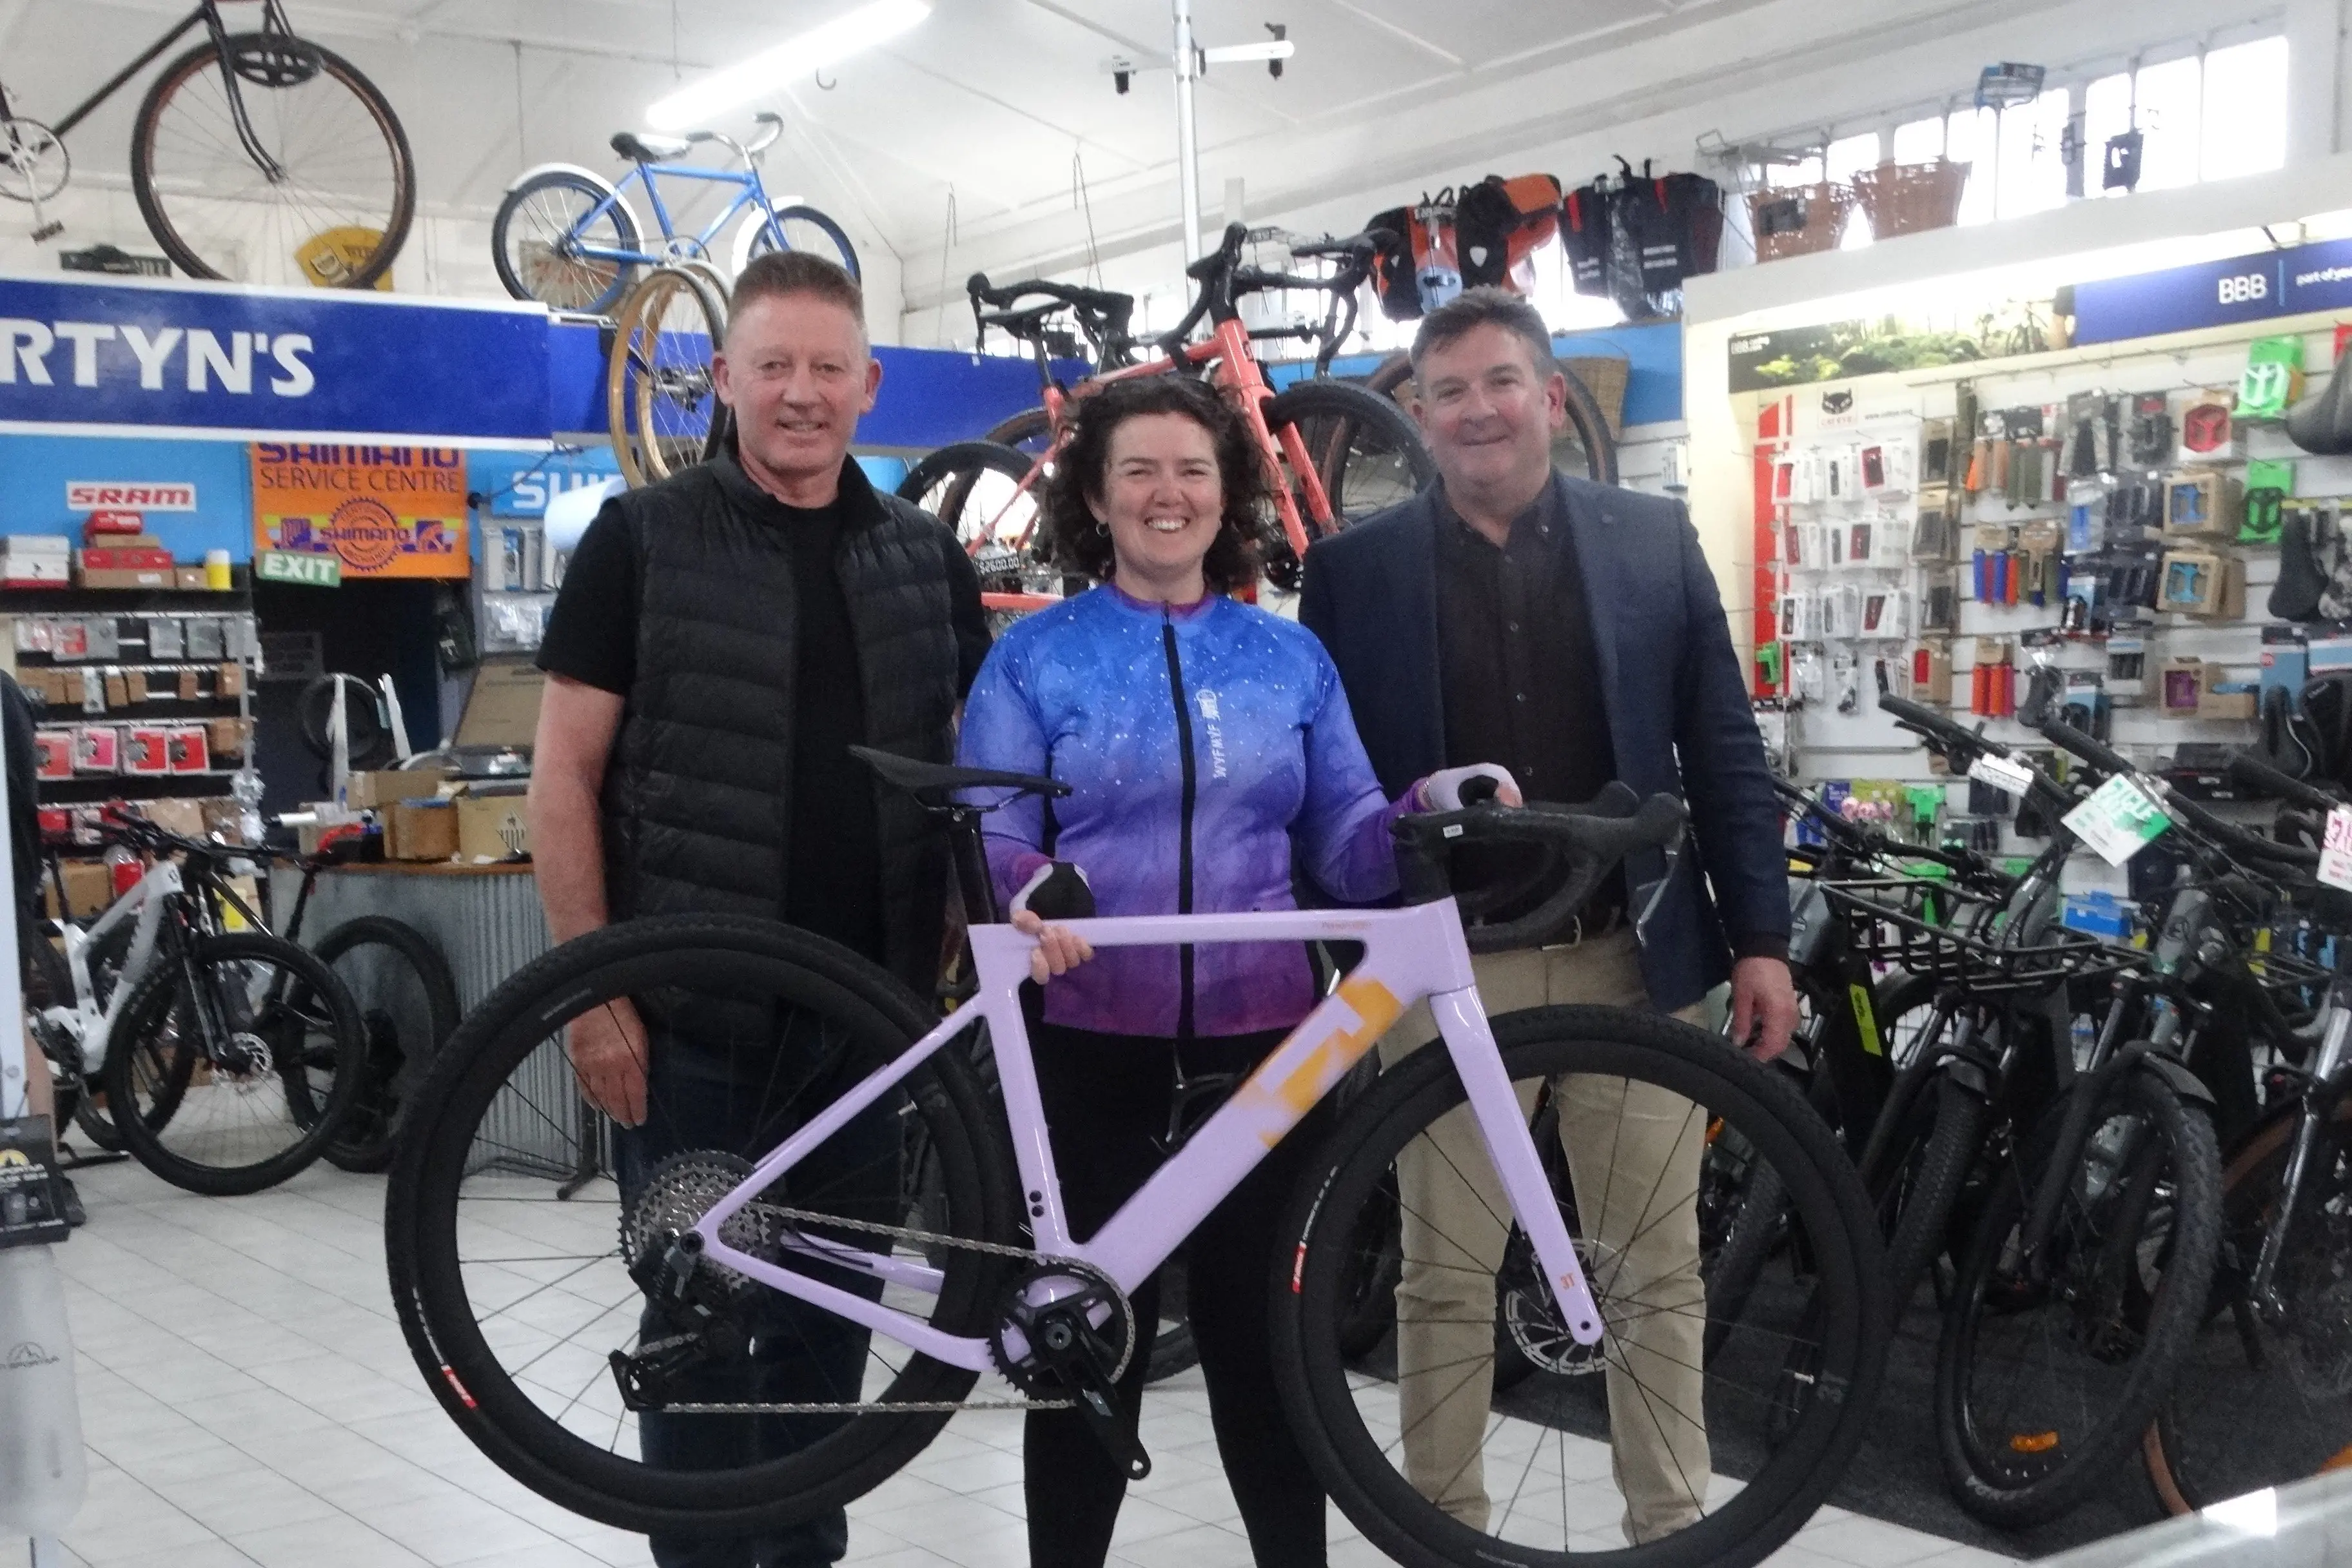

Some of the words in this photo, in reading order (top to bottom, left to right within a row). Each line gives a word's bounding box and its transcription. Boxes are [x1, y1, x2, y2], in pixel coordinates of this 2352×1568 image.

[2219, 273, 2268, 304] BBB
[0, 317, 315, 397] RTYN'S
[260, 467, 361, 492] SERVICE
[368, 469, 460, 493] CENTRE
[70, 488, 190, 506] SRAM
[264, 553, 335, 582] EXIT
